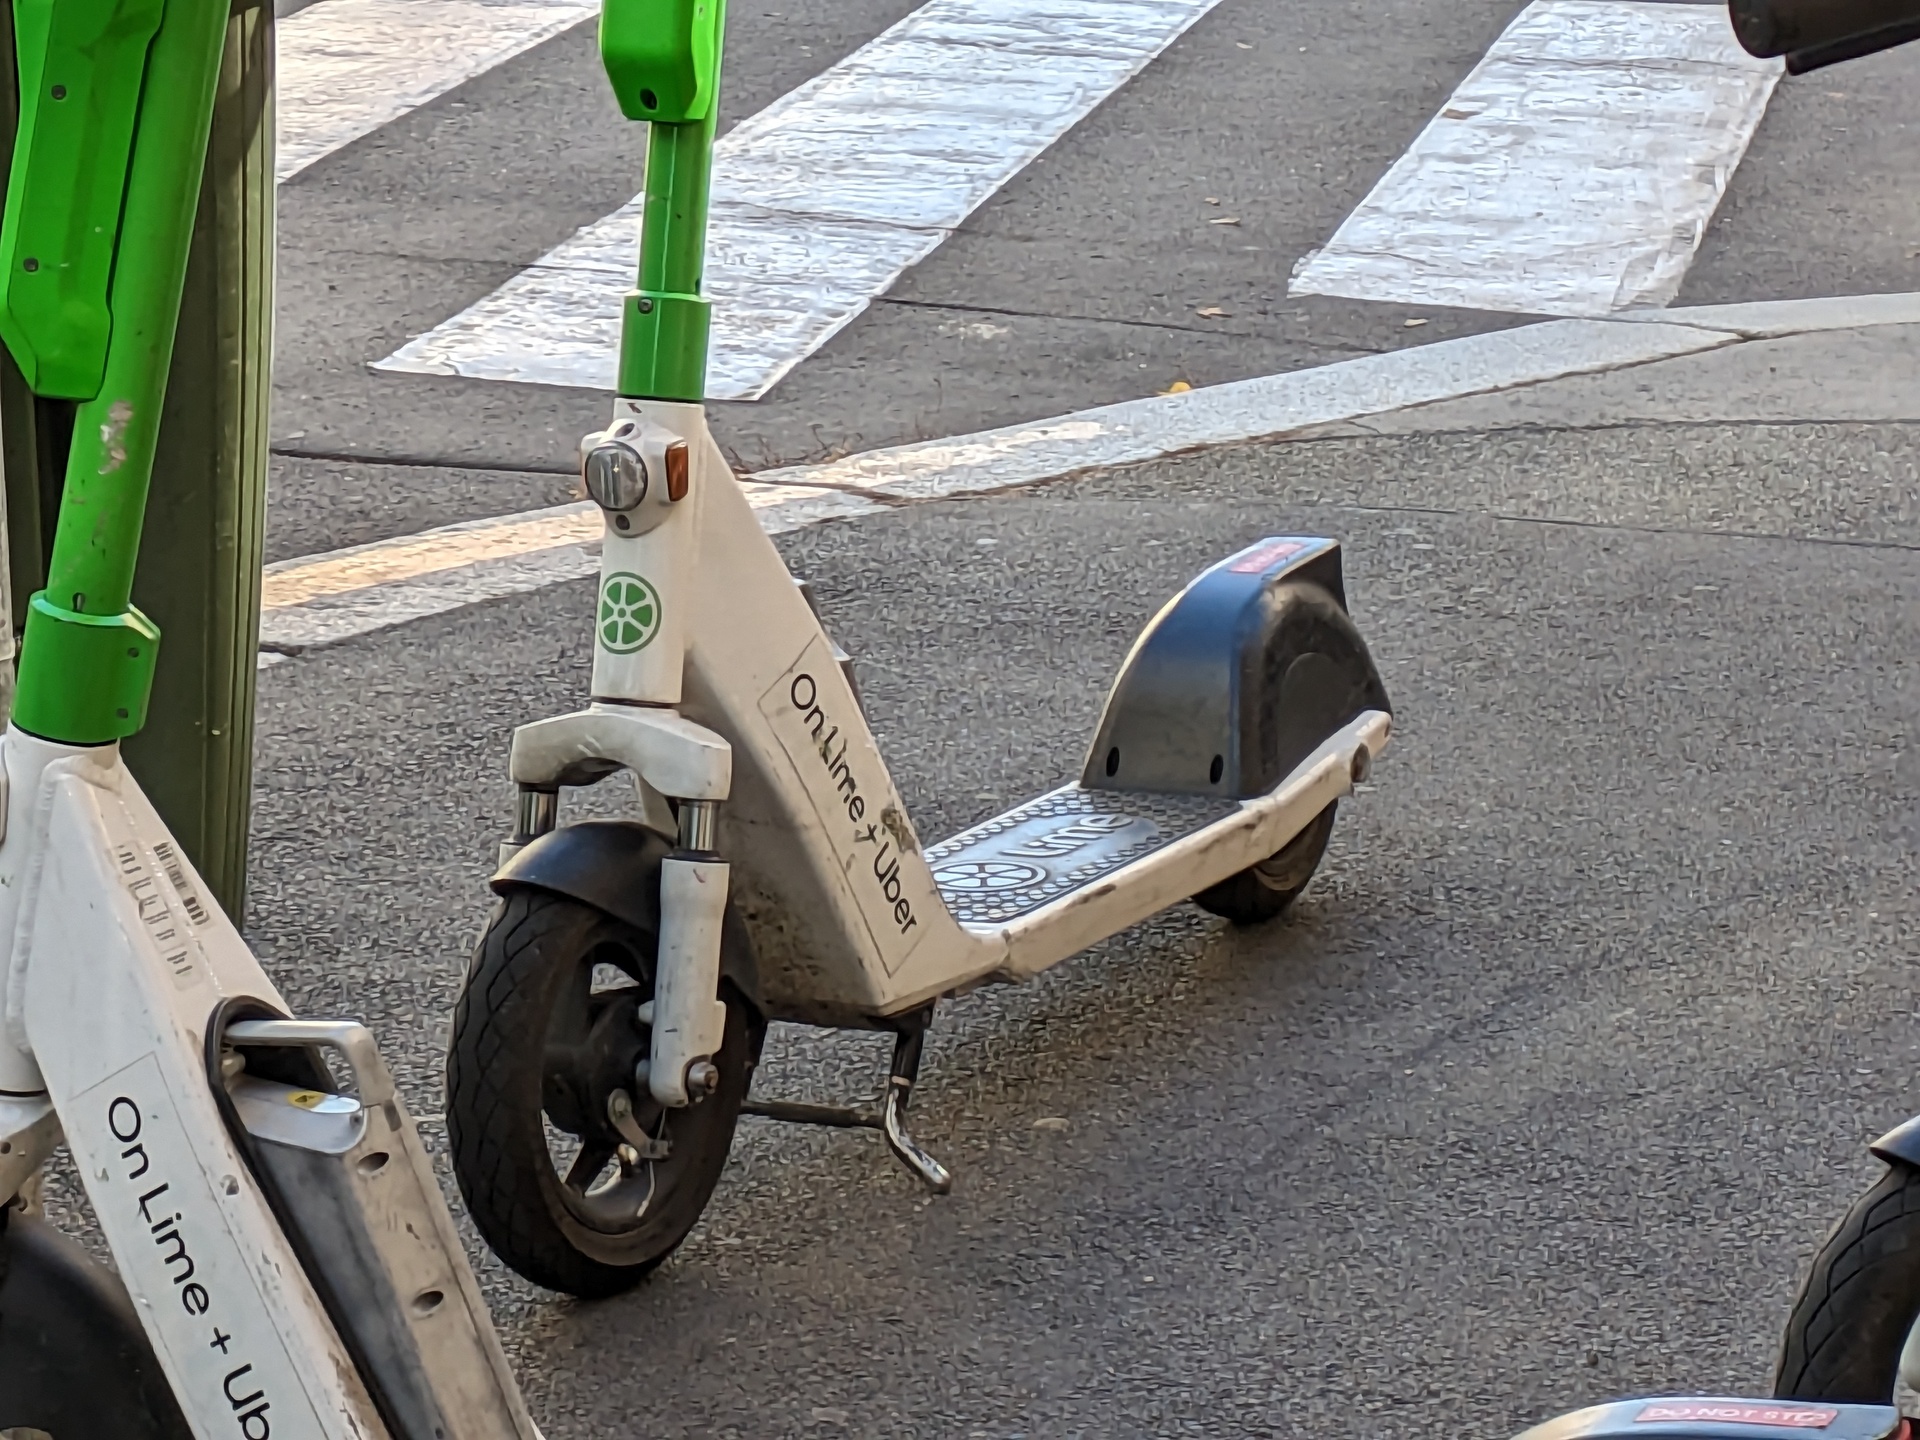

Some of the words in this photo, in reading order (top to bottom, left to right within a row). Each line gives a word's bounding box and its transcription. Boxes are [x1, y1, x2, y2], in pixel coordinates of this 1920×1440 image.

[791, 673, 825, 742] On
[819, 725, 865, 823] Lime
[873, 841, 918, 935] Uber
[1000, 812, 1135, 857] Lime
[108, 1096, 150, 1180] On
[138, 1182, 210, 1316] Lime
[209, 1326, 231, 1355] +
[1648, 1407, 1691, 1418] DO
[1696, 1408, 1759, 1419] NOT
[1763, 1409, 1828, 1422] STEP
